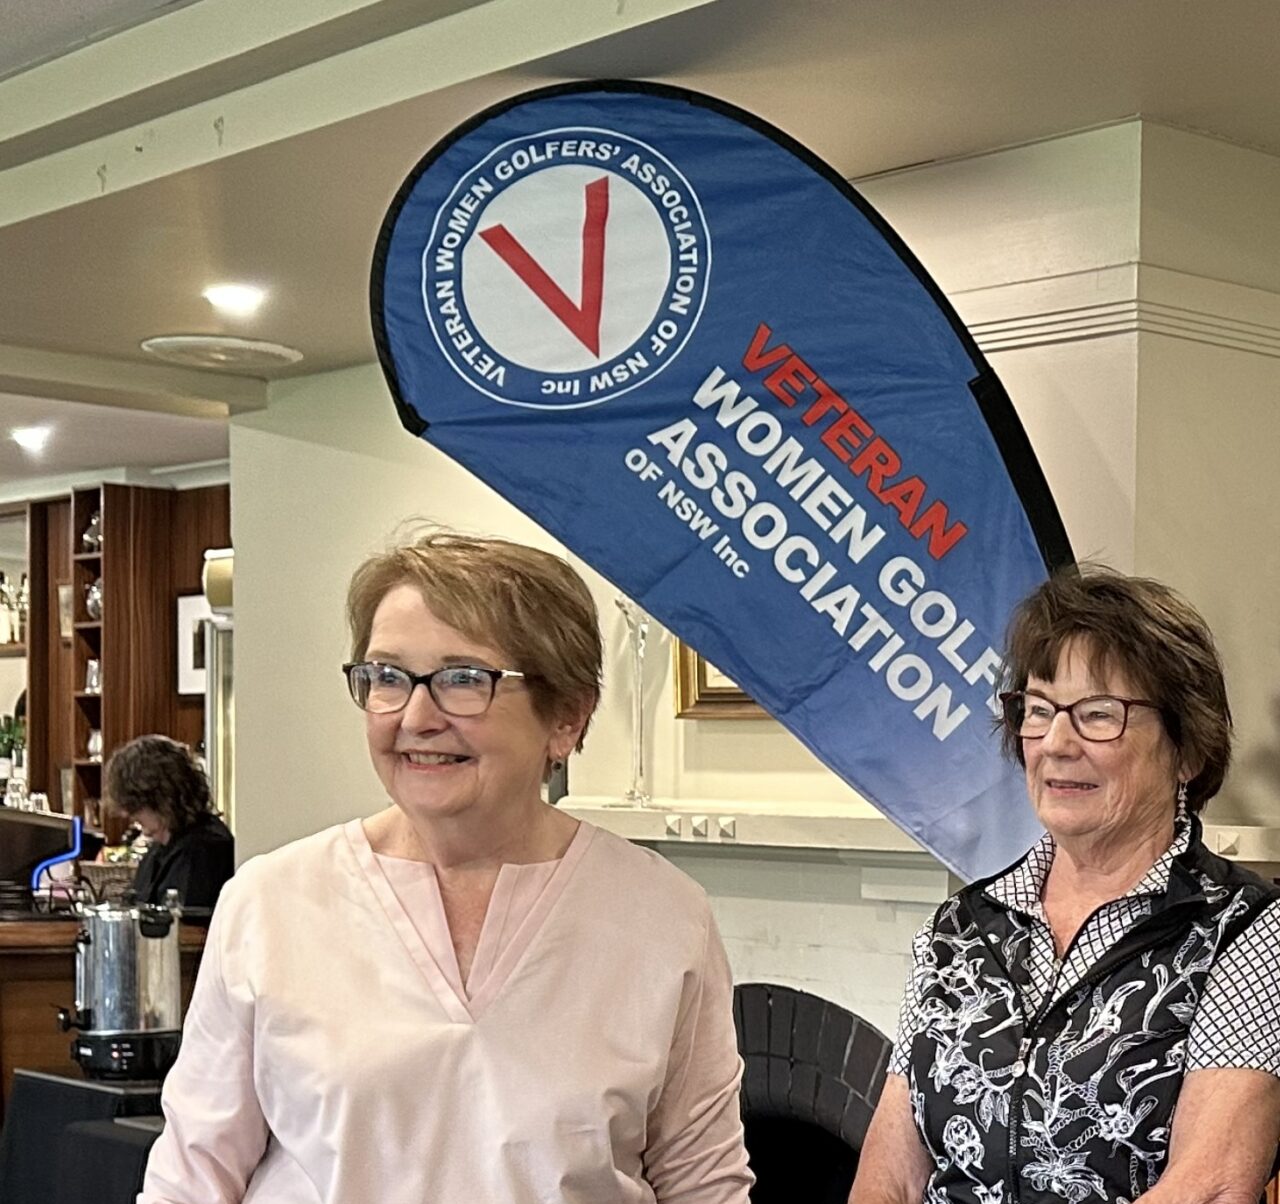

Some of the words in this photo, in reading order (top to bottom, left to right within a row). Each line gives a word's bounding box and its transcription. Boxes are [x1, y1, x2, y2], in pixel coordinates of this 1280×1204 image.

[436, 177, 494, 272] WOMEN
[620, 154, 698, 316] ASSOCIATION
[436, 280, 506, 387] VETERAN
[541, 379, 580, 396] Inc
[590, 351, 649, 393] NSW
[651, 320, 678, 356] OF
[742, 322, 969, 560] VETERAN
[624, 448, 664, 483] OF
[657, 479, 719, 542] NSW
[712, 536, 750, 579] Inc
[693, 366, 886, 564] WOMEN
[878, 556, 1003, 718] GOLF
[646, 418, 971, 742] ASSOCIATION
